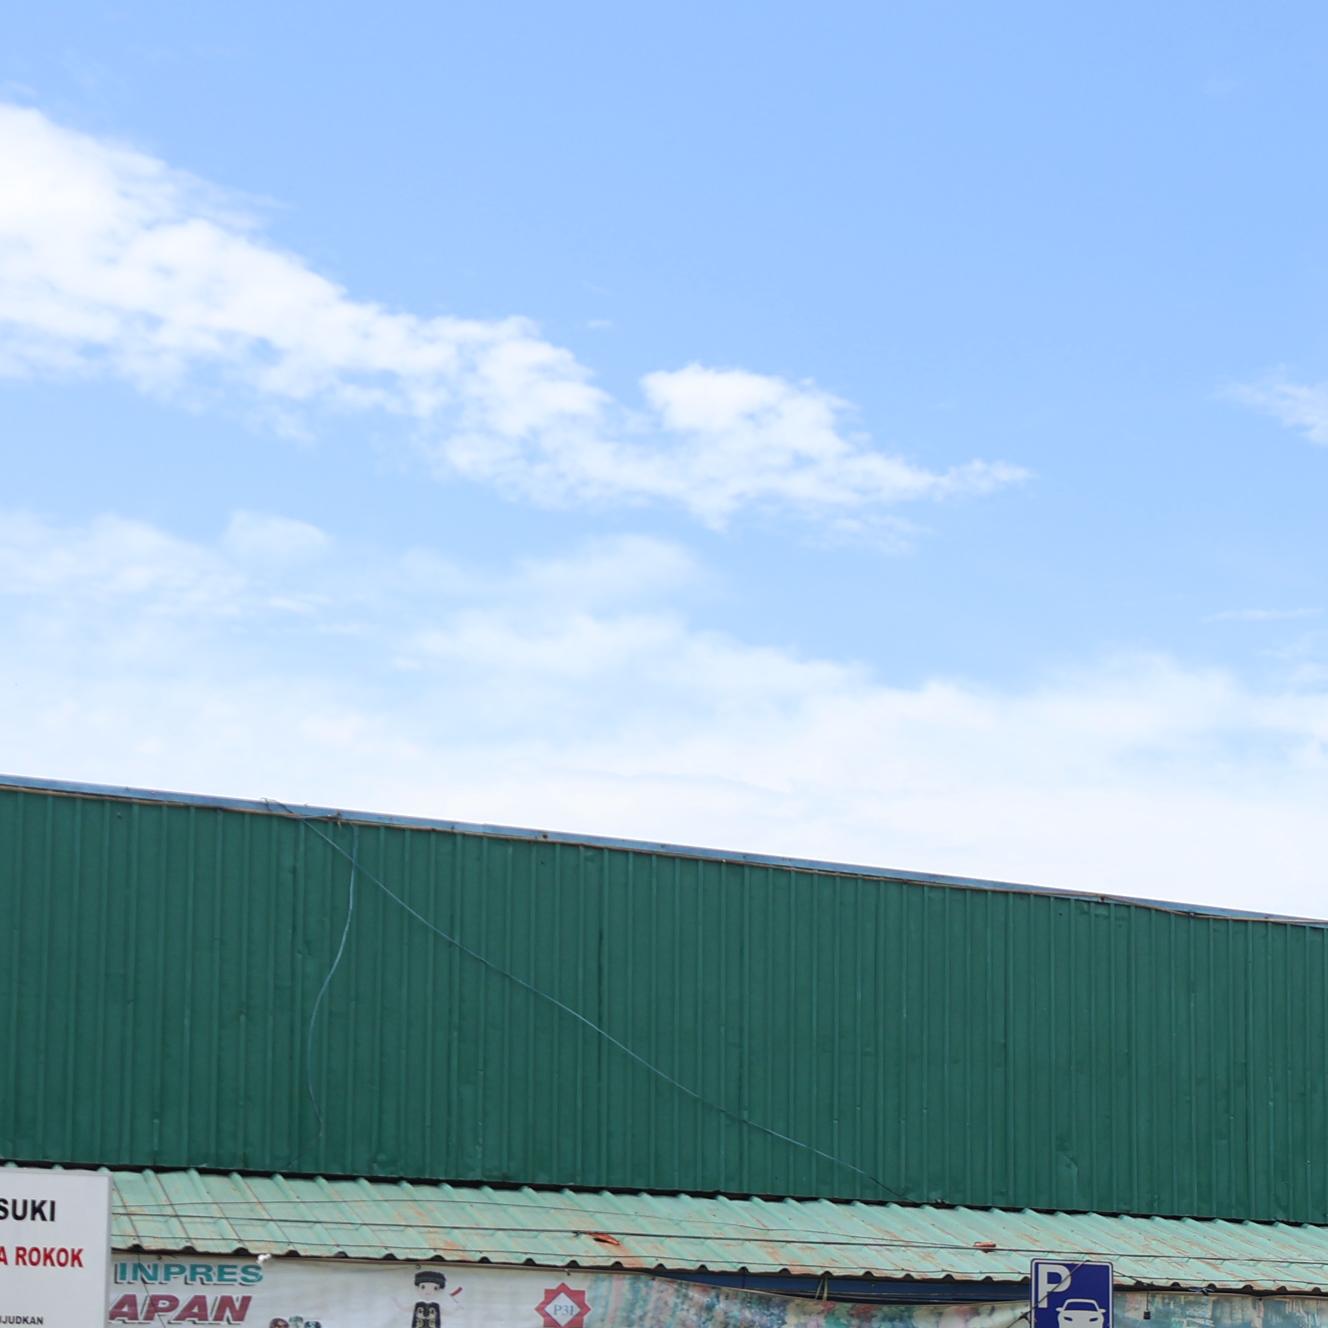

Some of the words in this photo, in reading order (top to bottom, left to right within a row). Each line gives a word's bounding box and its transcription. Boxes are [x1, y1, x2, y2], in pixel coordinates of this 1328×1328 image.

[15, 1246, 84, 1268] ROKOK
[115, 1262, 264, 1285] INPRES
[1038, 1264, 1072, 1308] P
[0, 1315, 43, 1325] JUDKAN
